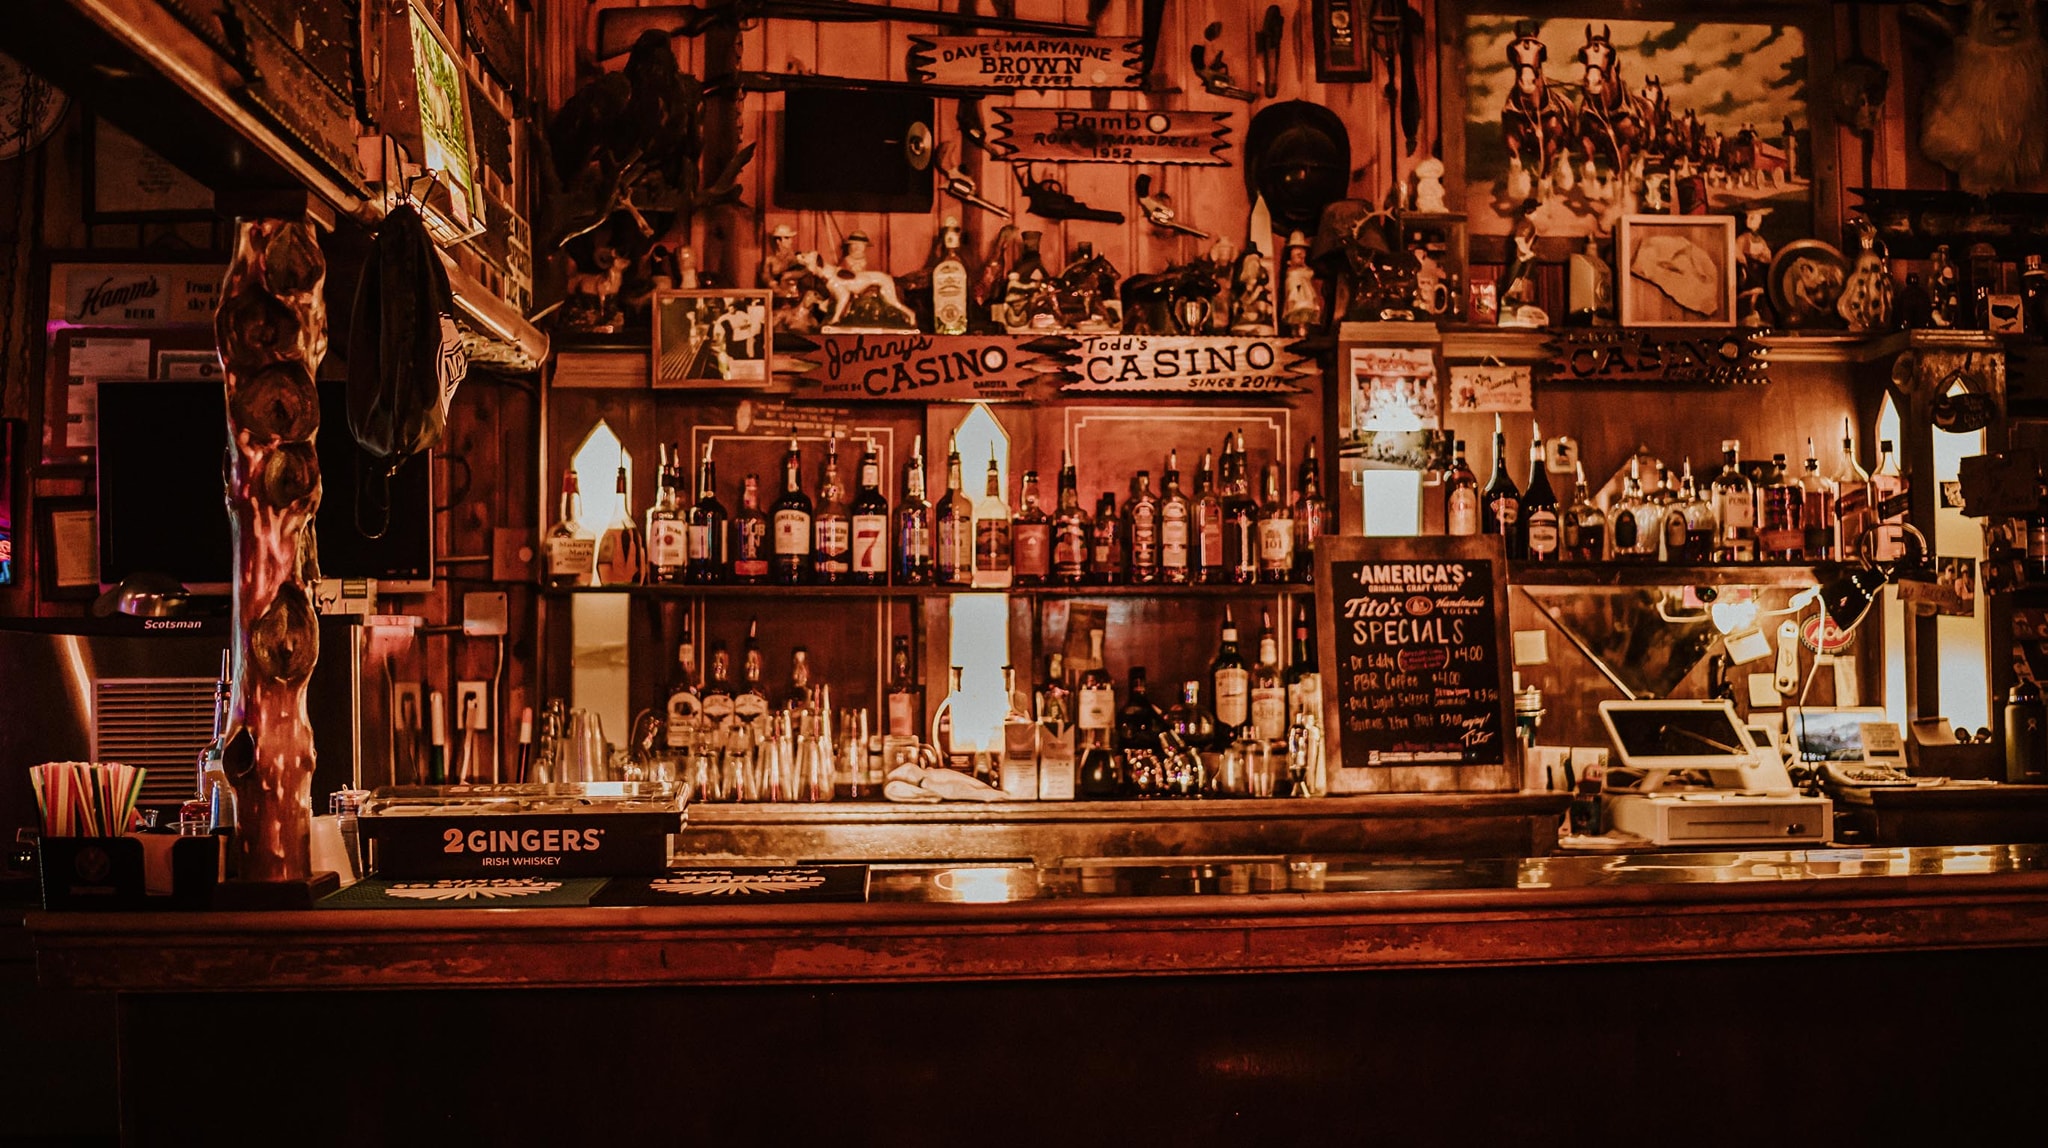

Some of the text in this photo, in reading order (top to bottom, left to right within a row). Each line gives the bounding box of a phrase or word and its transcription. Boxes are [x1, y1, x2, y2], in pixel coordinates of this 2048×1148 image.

[943, 43, 989, 63] DAVE
[1006, 40, 1112, 62] MARYANNE
[980, 57, 1083, 74] BROWN
[993, 75, 1074, 85] FOR EVER
[1092, 148, 1132, 159] 1952
[74, 275, 160, 320] Hamm's
[125, 308, 155, 319] BEER
[1083, 336, 1148, 354] Todd's
[825, 335, 933, 380] Johnny's
[1087, 342, 1274, 384] CASINO
[863, 345, 1008, 396] CASINO
[973, 380, 1008, 389] DAKOTA
[1188, 375, 1283, 389] SINCE 2017
[979, 389, 1026, 398] TERRITORY
[857, 530, 881, 567] 7
[1360, 563, 1465, 585] AMERICA'S
[1368, 584, 1404, 593] ORIGINAL
[1344, 595, 1485, 618] Tito's Handmade
[1442, 608, 1479, 616] VODKA
[144, 619, 202, 630] Scotsman
[1353, 617, 1464, 645] SPECIALS
[1368, 652, 1395, 671] Eddy
[1353, 673, 1380, 691] PBR
[1460, 728, 1495, 748] Tito
[482, 856, 562, 867] IRISH WHISKEY
